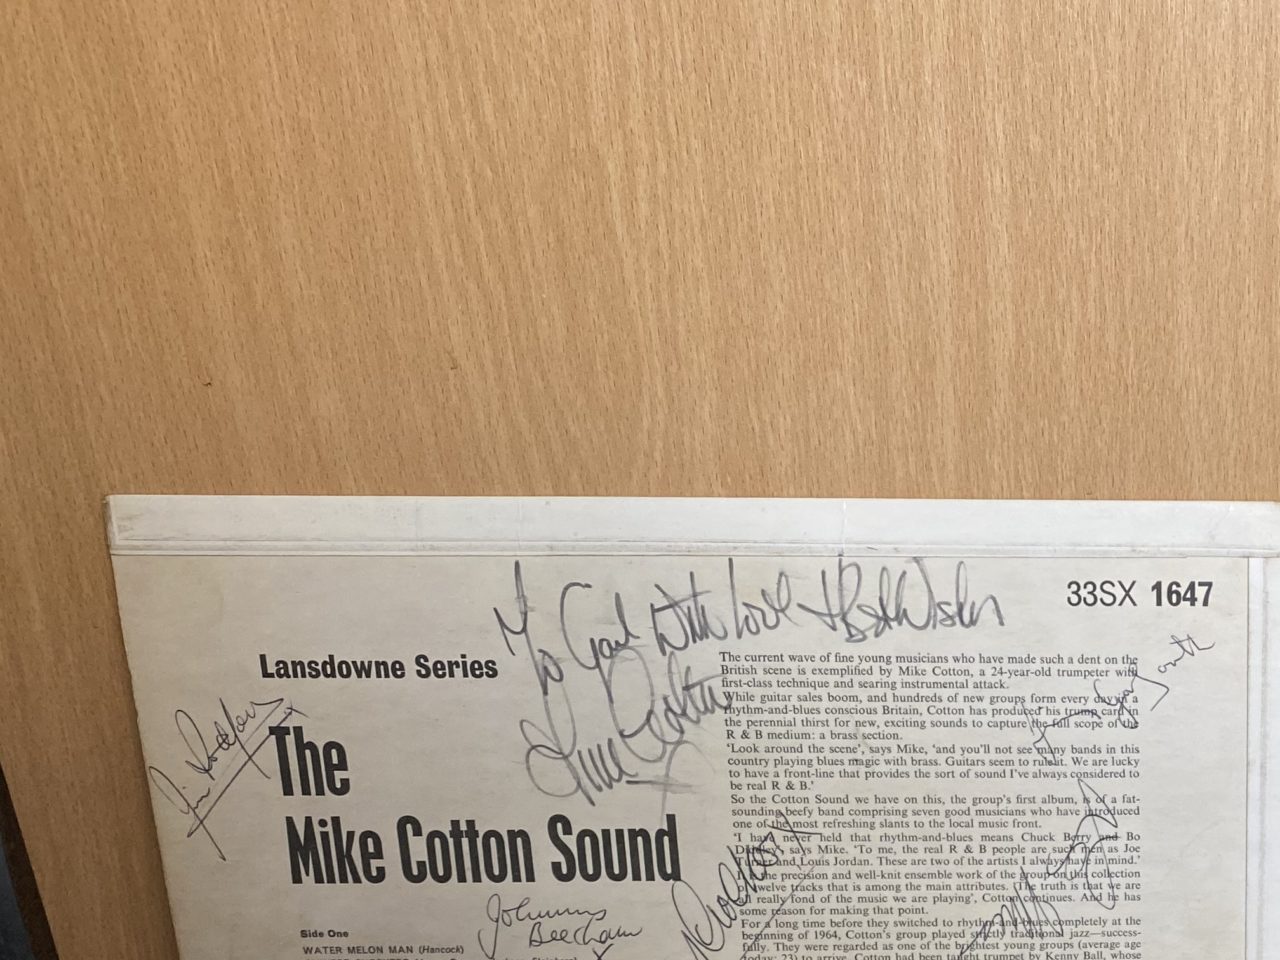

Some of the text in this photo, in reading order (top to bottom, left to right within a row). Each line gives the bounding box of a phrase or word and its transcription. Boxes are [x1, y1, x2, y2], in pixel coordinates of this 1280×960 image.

[1067, 580, 1213, 607] 33SX 1647
[259, 654, 498, 679] Lansdowne Series
[720, 652, 741, 662] The
[744, 652, 784, 663] current
[788, 655, 815, 663] wave
[820, 653, 832, 663] of
[835, 653, 854, 663] fine
[856, 656, 892, 666] young
[895, 653, 949, 664] musicians
[952, 654, 975, 664] who
[979, 654, 1004, 664] have
[1007, 654, 1036, 664] made
[1040, 654, 1064, 664] such
[1077, 655, 1101, 665] dent
[1105, 657, 1118, 665] on
[1122, 655, 1138, 665] the
[721, 666, 1138, 680] British scene is exemplified by Mike Cotton, a 24-year-old trumpeter with
[722, 679, 1009, 692] first-class technique and searing instrumental attack.
[268, 725, 351, 797] The
[286, 814, 684, 884] Mike Cotton Sound
[300, 929, 349, 938] Side One
